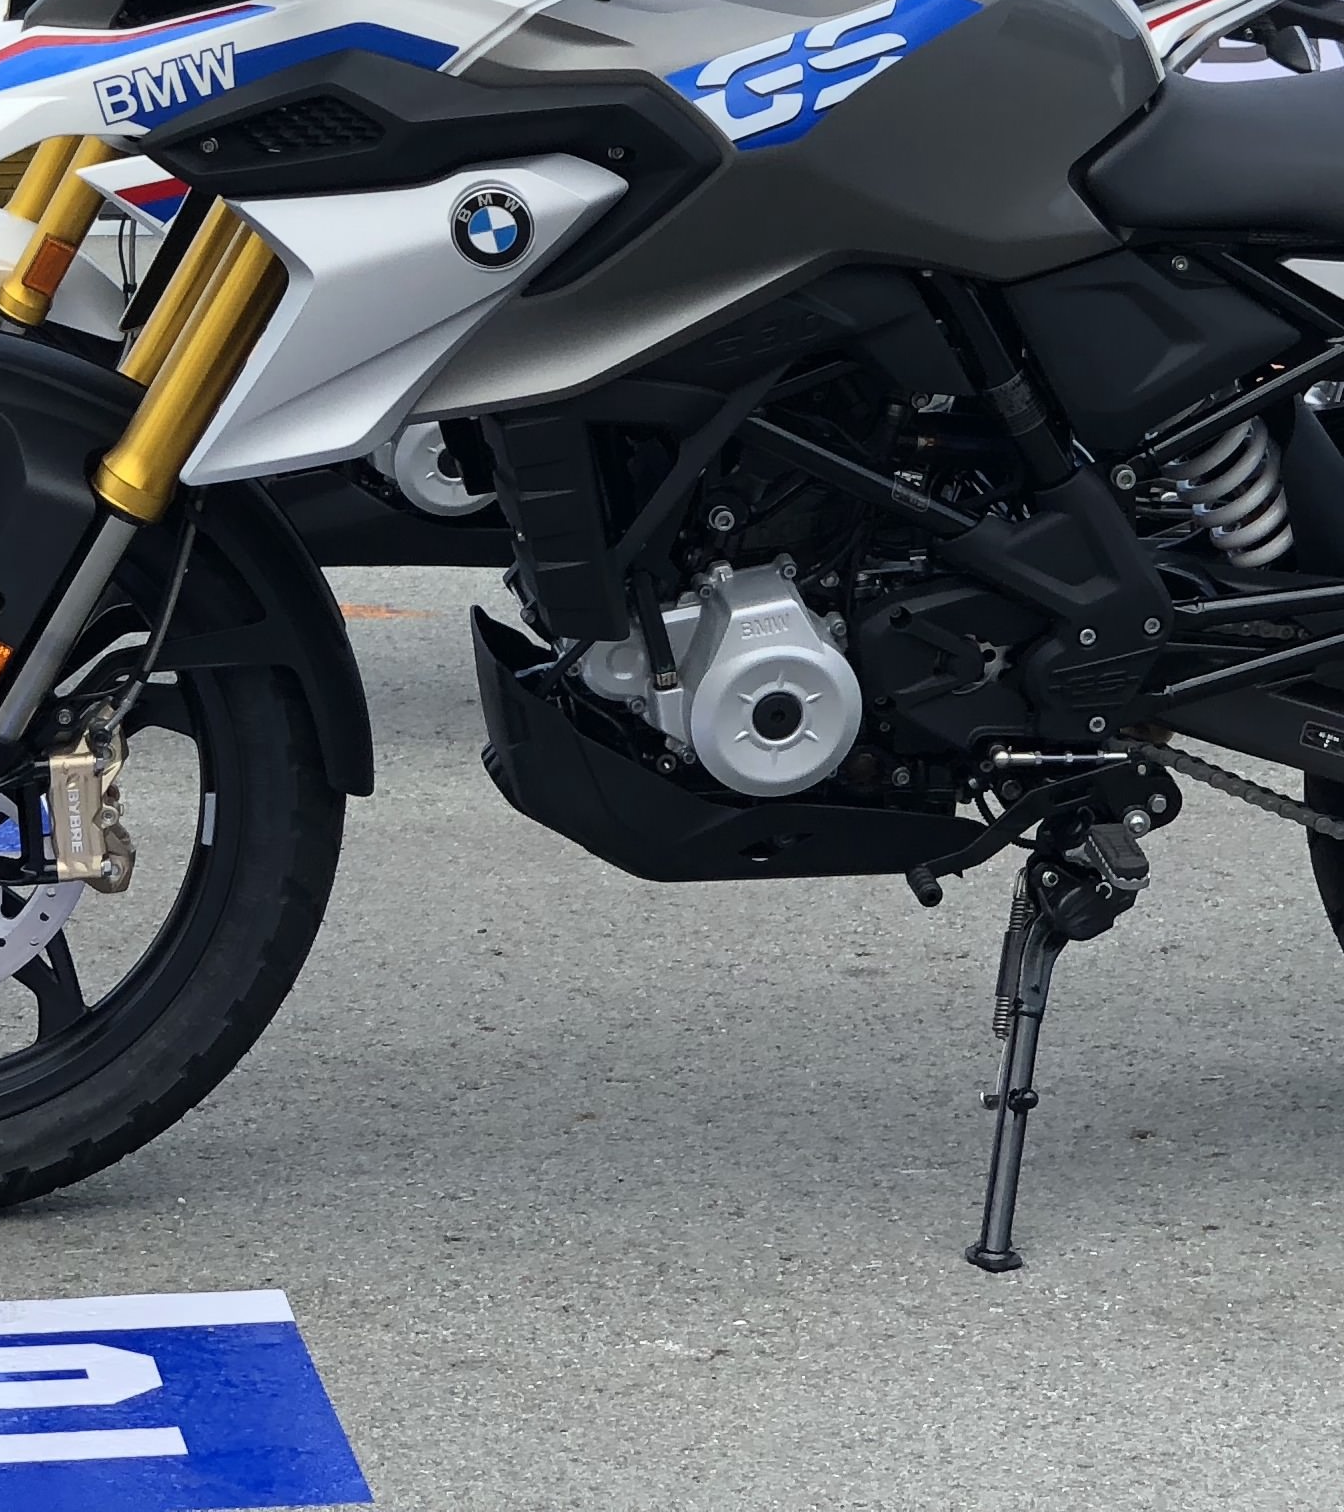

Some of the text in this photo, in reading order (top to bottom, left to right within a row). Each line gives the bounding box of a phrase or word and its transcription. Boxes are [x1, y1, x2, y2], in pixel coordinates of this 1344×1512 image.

[93, 42, 237, 125] BMW
[457, 192, 522, 224] BMW
[740, 612, 790, 641] BMW
[67, 789, 84, 854] BYBRE
